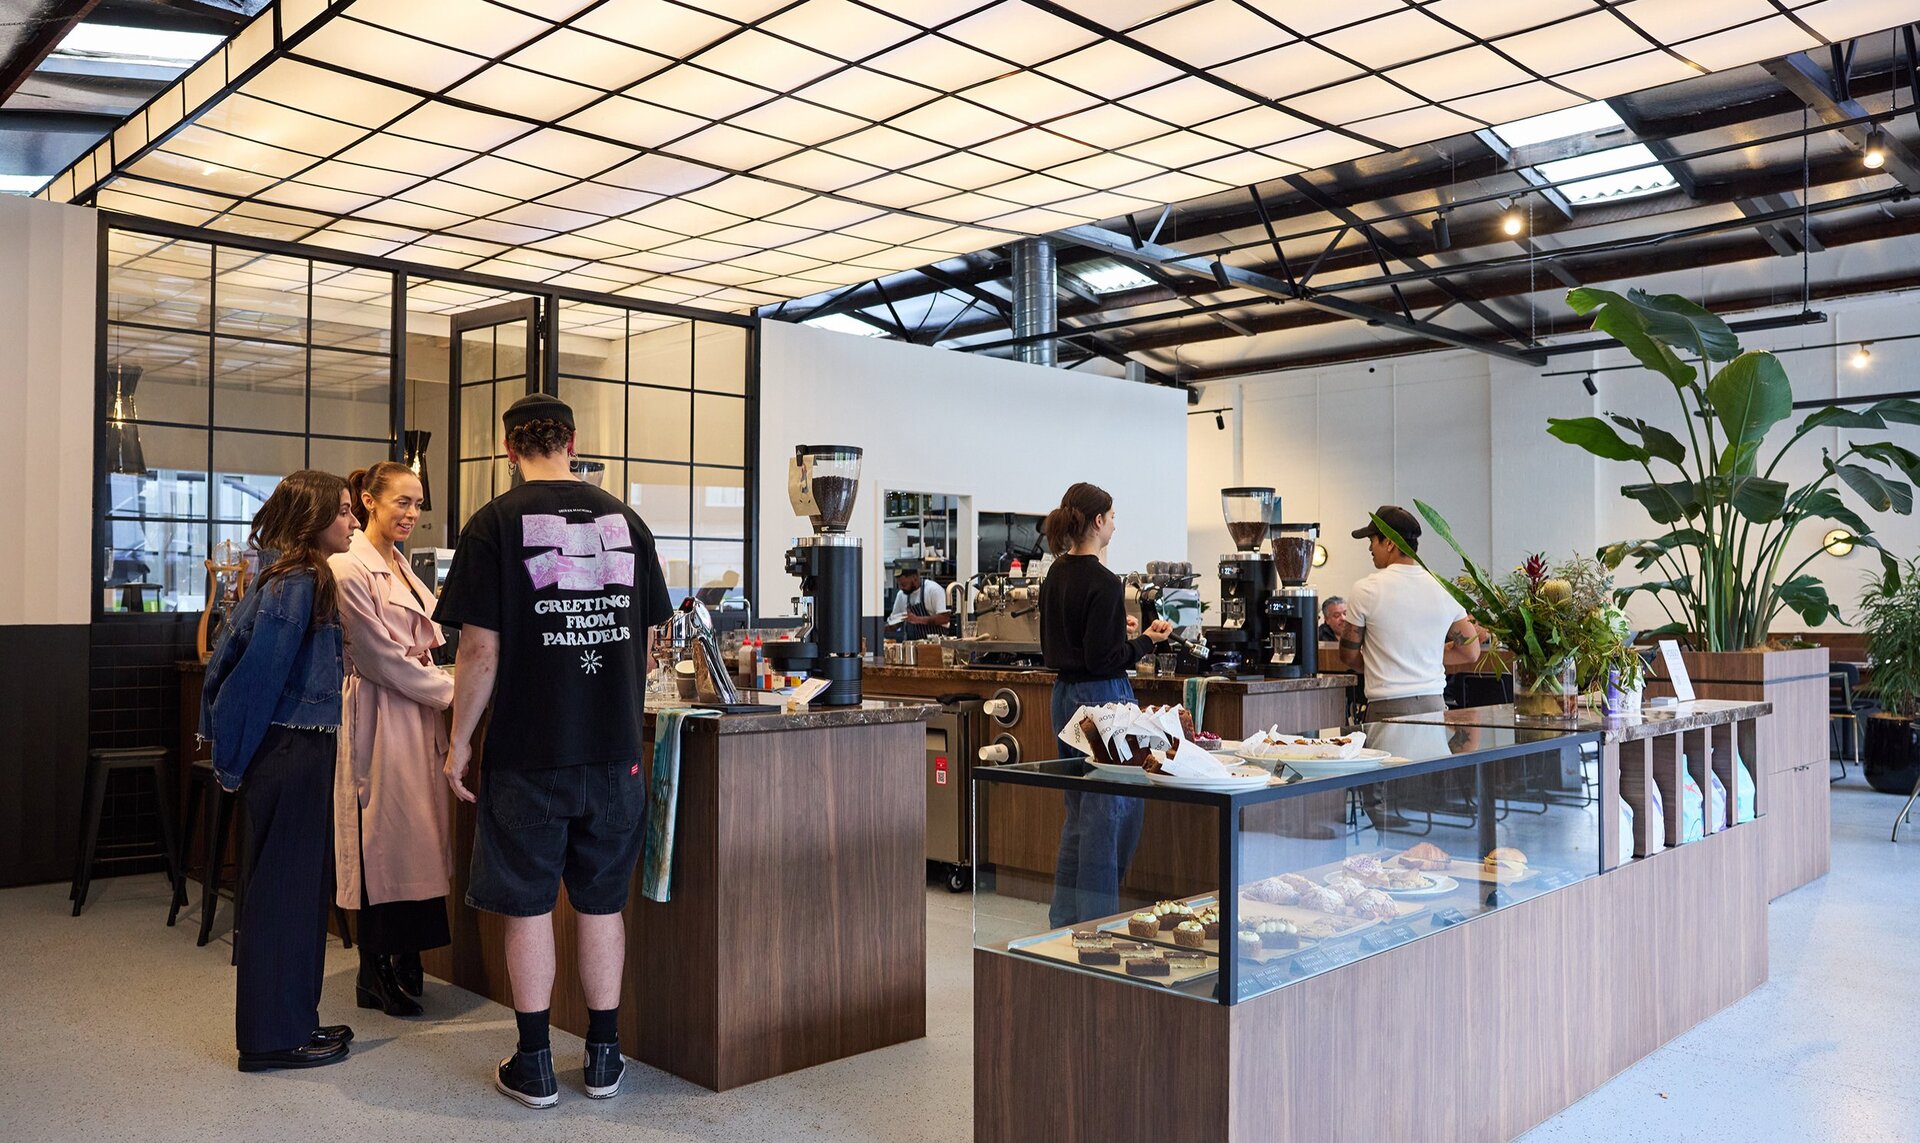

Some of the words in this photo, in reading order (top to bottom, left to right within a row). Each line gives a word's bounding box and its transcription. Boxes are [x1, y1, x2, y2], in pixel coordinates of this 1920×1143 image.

[534, 595, 630, 614] GREETINGS
[566, 612, 616, 629] FROM
[542, 626, 631, 646] PARADEUS
